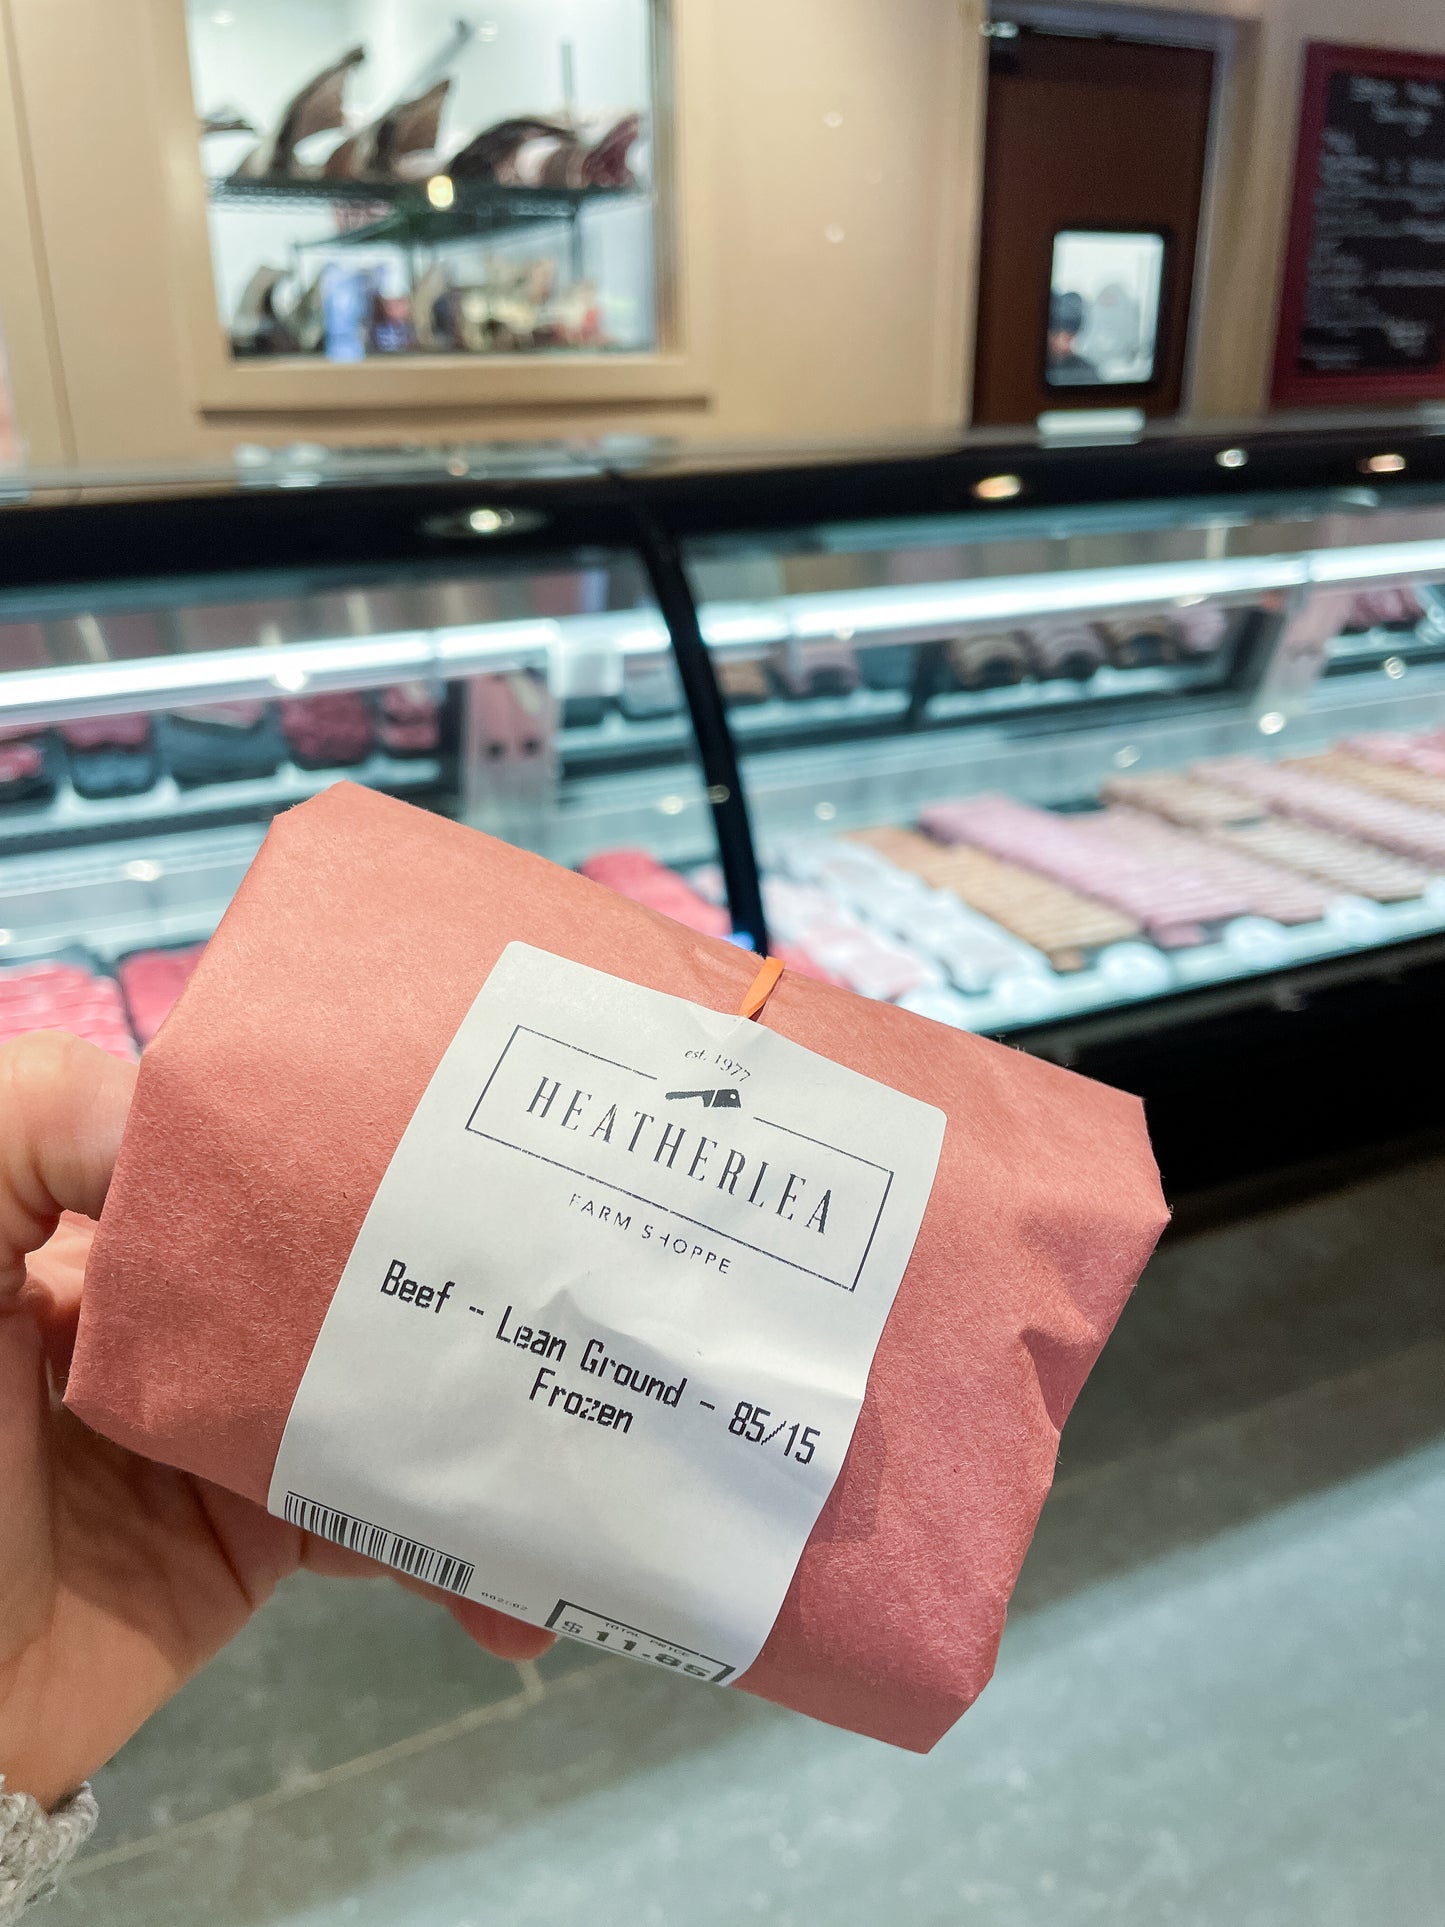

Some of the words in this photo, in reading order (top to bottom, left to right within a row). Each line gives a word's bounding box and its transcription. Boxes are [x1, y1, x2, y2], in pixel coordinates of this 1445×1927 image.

[684, 1049, 707, 1061] est.
[715, 1054, 751, 1082] 1977
[526, 1076, 832, 1235] HEATHERLEA
[569, 1193, 632, 1231] FARM
[641, 1224, 731, 1274] SHOPPE
[380, 1259, 456, 1314] Beef
[495, 1305, 567, 1362] Lean
[579, 1338, 688, 1408] Ground
[699, 1400, 716, 1411] -
[727, 1400, 821, 1465] 85/15
[528, 1367, 634, 1434] Frozen
[604, 1621, 642, 1638] TOTAL
